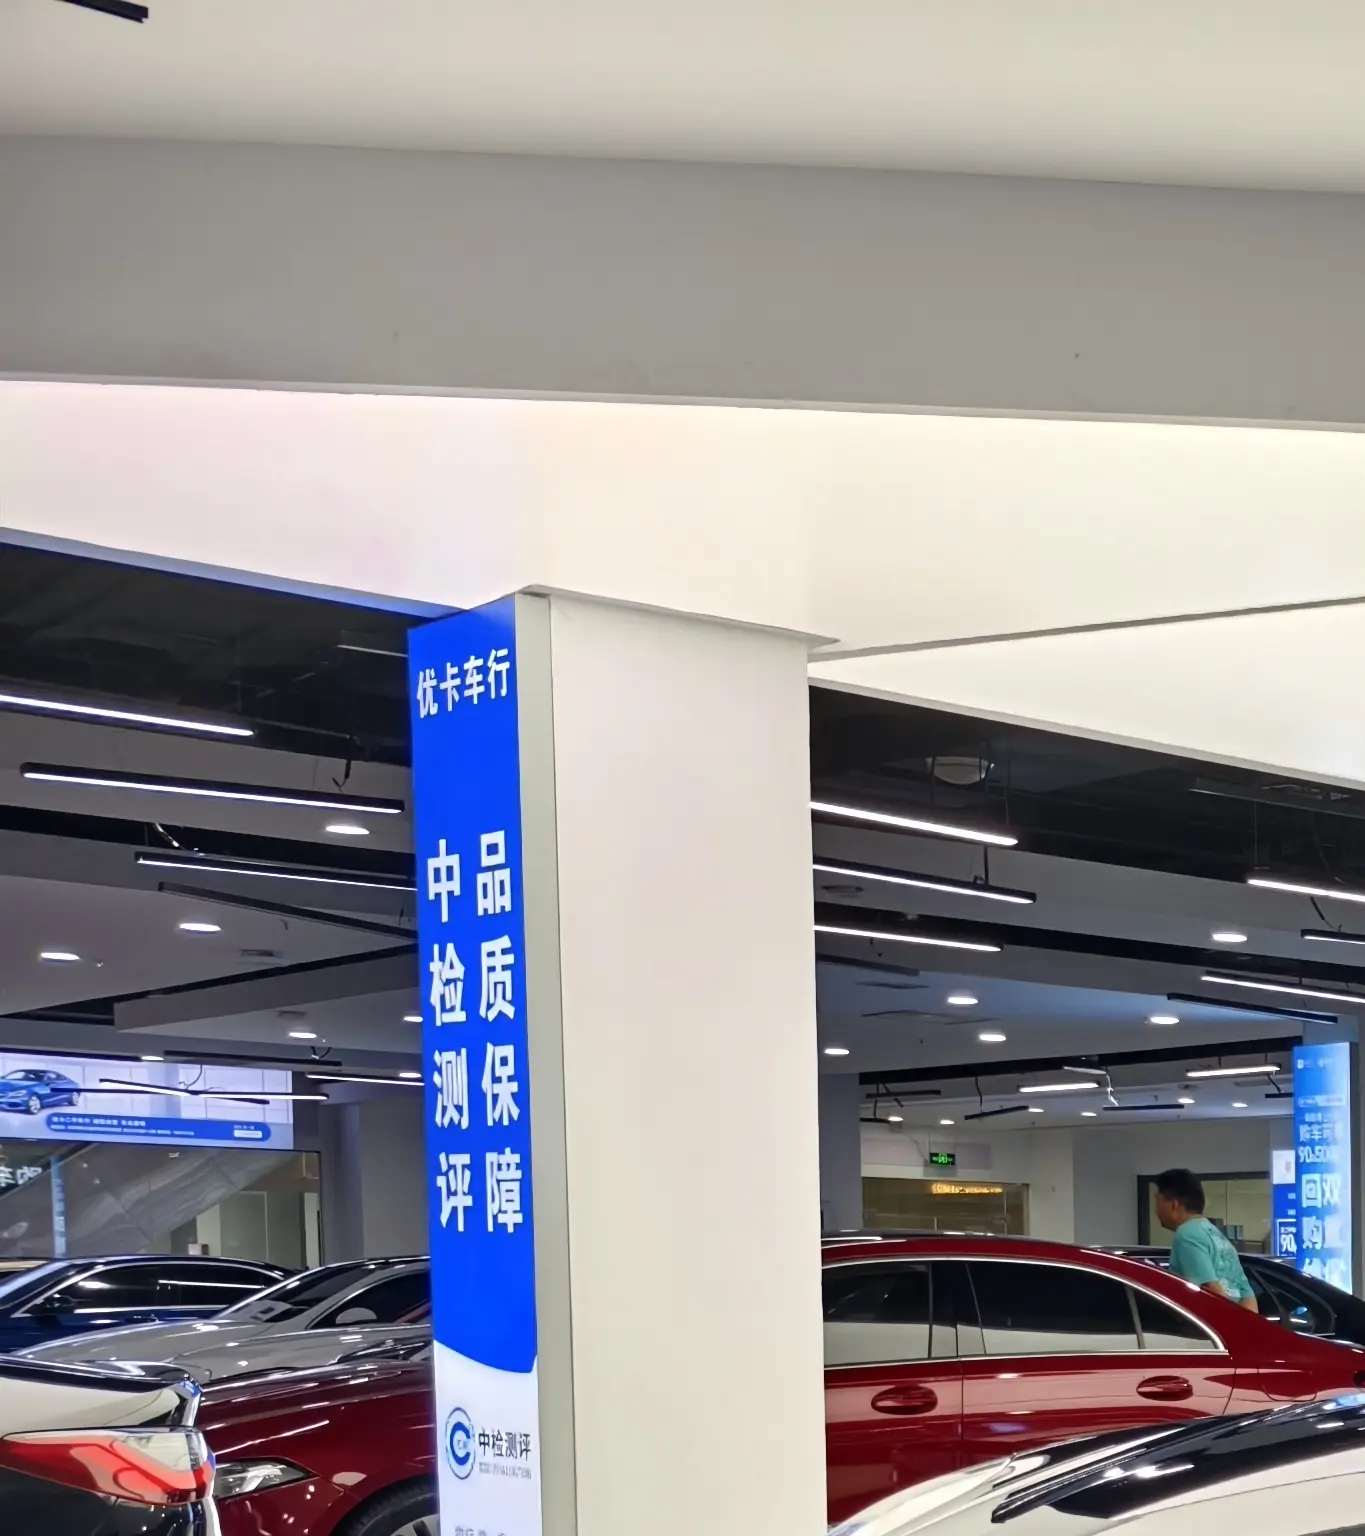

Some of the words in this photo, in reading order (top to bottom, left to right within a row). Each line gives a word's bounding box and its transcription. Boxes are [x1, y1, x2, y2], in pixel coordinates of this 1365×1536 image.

[416, 648, 510, 718] 优卡车行
[427, 838, 473, 1233] 中检测评
[475, 830, 524, 1233] 品质保障
[478, 1426, 532, 1462] 中检测评
